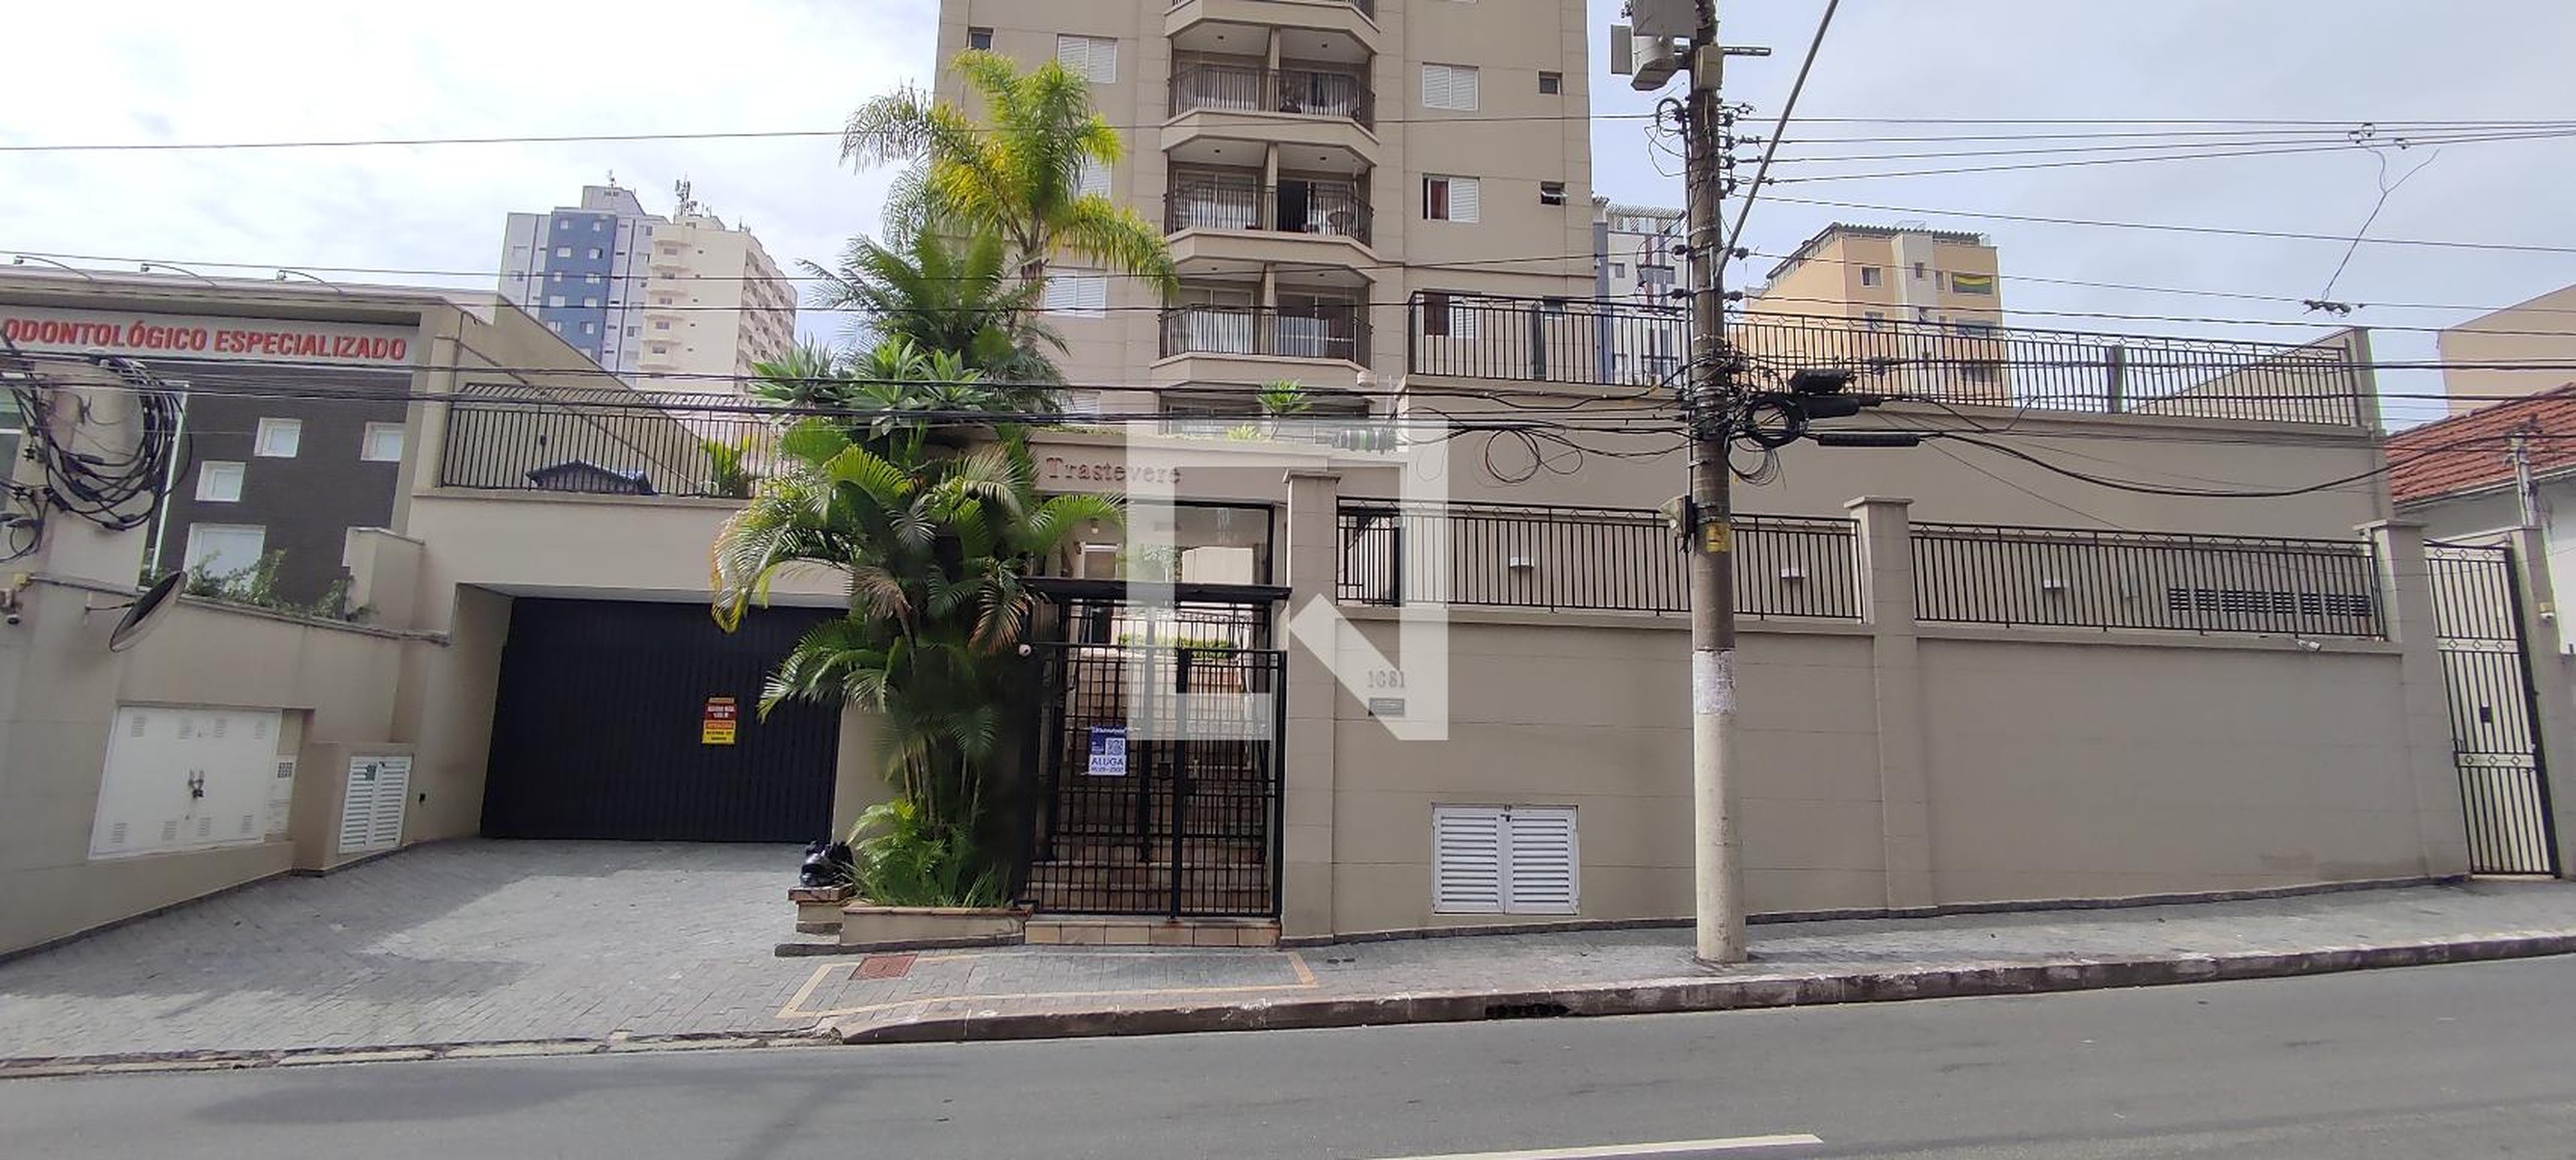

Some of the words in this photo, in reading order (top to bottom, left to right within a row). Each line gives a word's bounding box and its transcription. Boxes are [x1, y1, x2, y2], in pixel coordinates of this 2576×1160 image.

[3, 318, 207, 351] ODONTOLÓGICO
[214, 330, 407, 360] ESPECIALIZADO
[1046, 457, 1181, 484] Trastevere
[1368, 670, 1404, 688] 1081
[1091, 757, 1124, 766] ALUGA
